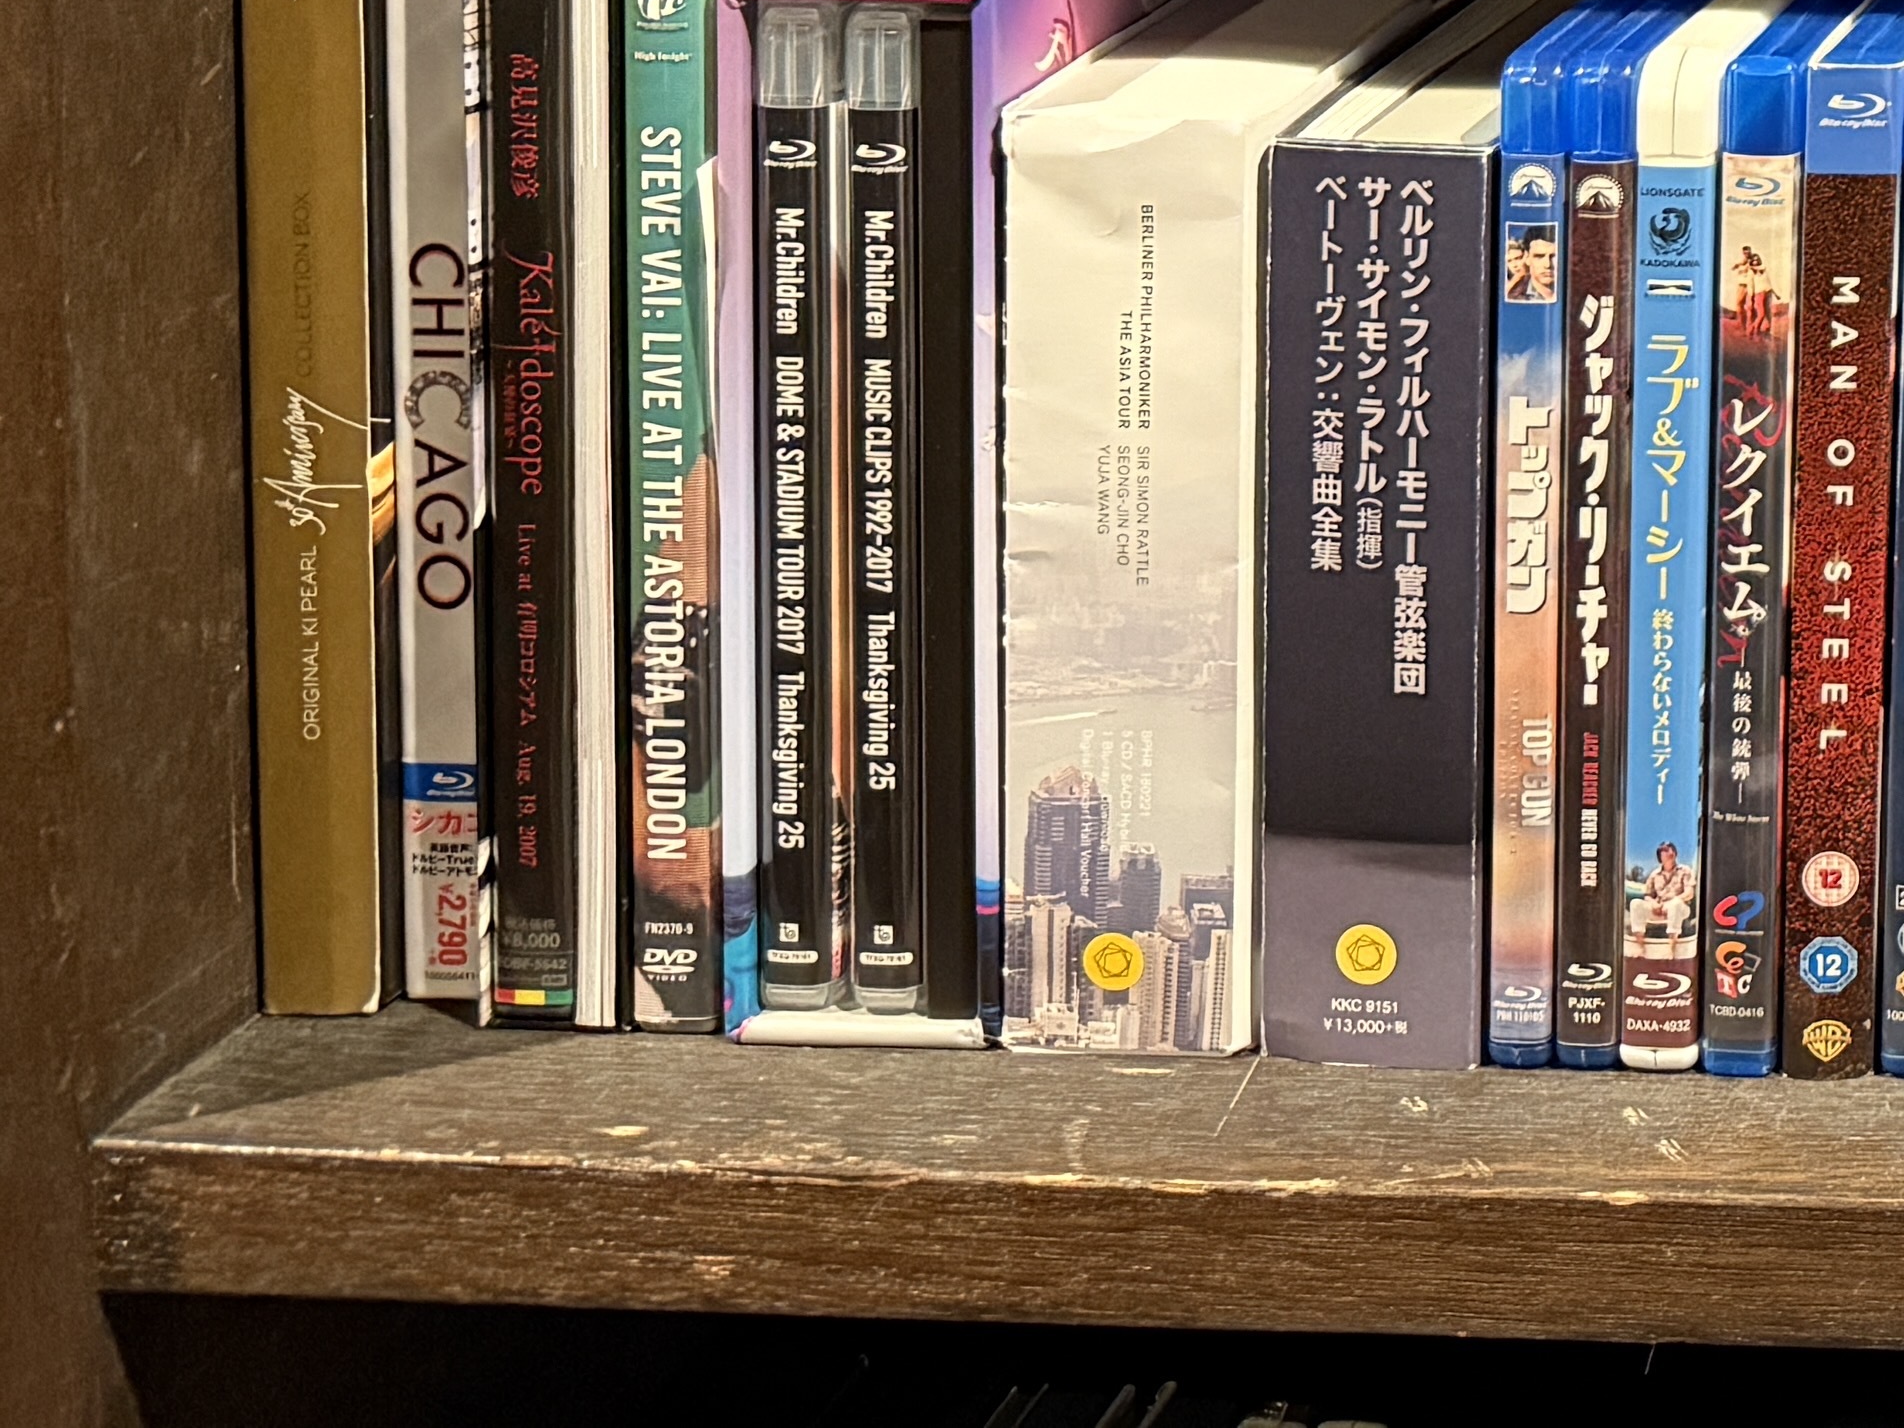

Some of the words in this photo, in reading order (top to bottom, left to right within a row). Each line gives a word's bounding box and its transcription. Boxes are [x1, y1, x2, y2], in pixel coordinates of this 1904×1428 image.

[640, 125, 682, 237] STEVE
[640, 246, 683, 320] VAI:
[774, 206, 805, 335] Mr.Children
[1140, 204, 1154, 282] BERLINER
[641, 331, 683, 410] LIVE
[1138, 288, 1153, 430] PHILHARMONIKER
[1828, 276, 1860, 392] MAN
[407, 242, 472, 611] CHICAGO
[775, 356, 804, 419] DOME
[1394, 177, 1433, 695] ベルリン・フィルハーモニー管弦楽団
[642, 417, 683, 466] AT
[775, 442, 805, 535] STADIUM
[1825, 438, 1856, 508] OF
[641, 478, 683, 543] THE
[1117, 532, 1131, 567] CHO
[1506, 395, 1557, 615] トップガン
[1577, 293, 1614, 706] ジャック・リーチャー
[775, 541, 805, 594] TOUR
[641, 553, 687, 707] ASTORIA
[775, 600, 805, 655] 2017
[1820, 559, 1852, 750] STEEL
[772, 670, 806, 815] Thanksgiving
[1648, 607, 1676, 805] 終わらないメロディー
[645, 719, 688, 862] LONDON
[776, 820, 805, 851] 25
[1331, 997, 1361, 1014] KKC
[1366, 998, 1399, 1014] 9151
